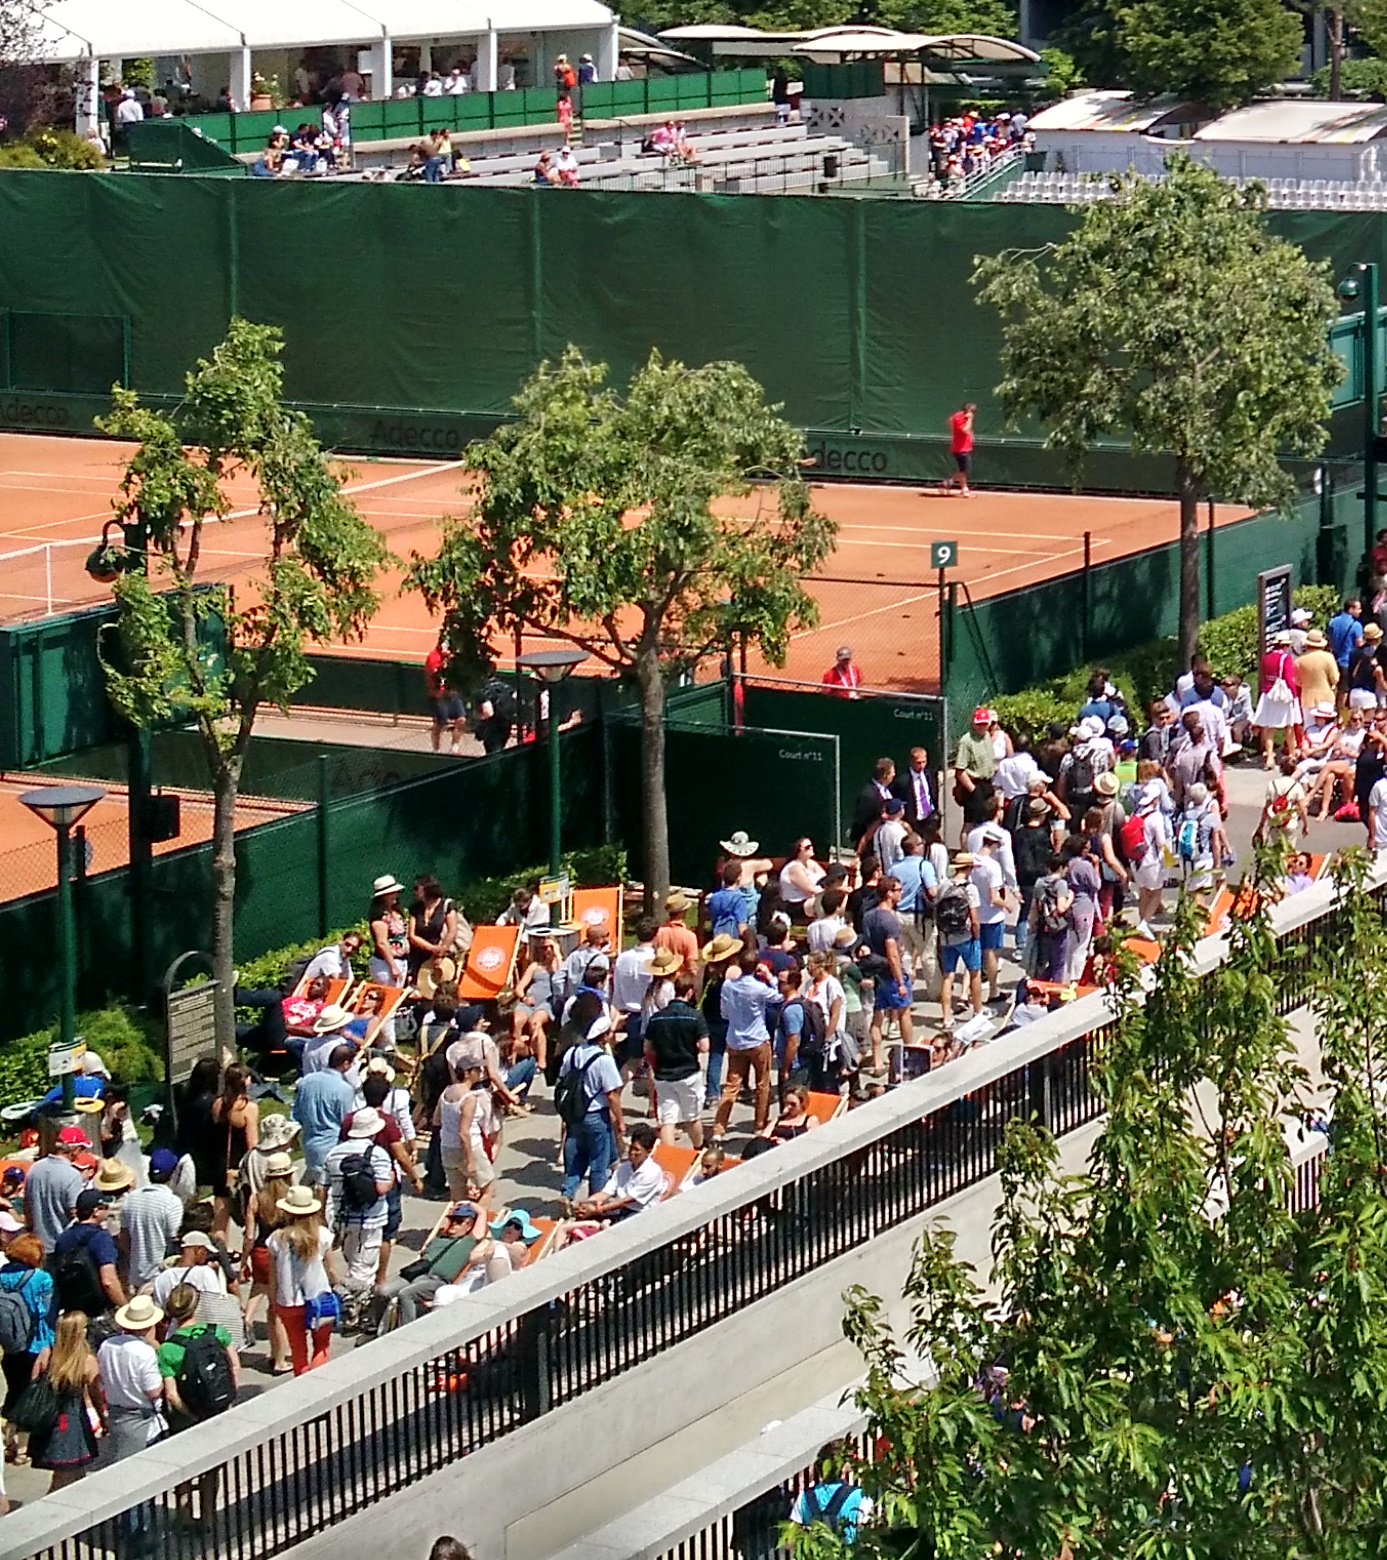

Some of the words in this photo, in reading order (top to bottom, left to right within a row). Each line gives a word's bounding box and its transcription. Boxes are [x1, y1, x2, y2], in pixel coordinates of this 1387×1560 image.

[800, 441, 888, 473] decco
[937, 546, 951, 564] 9
[894, 708, 915, 719] Court
[778, 749, 801, 760] Court
